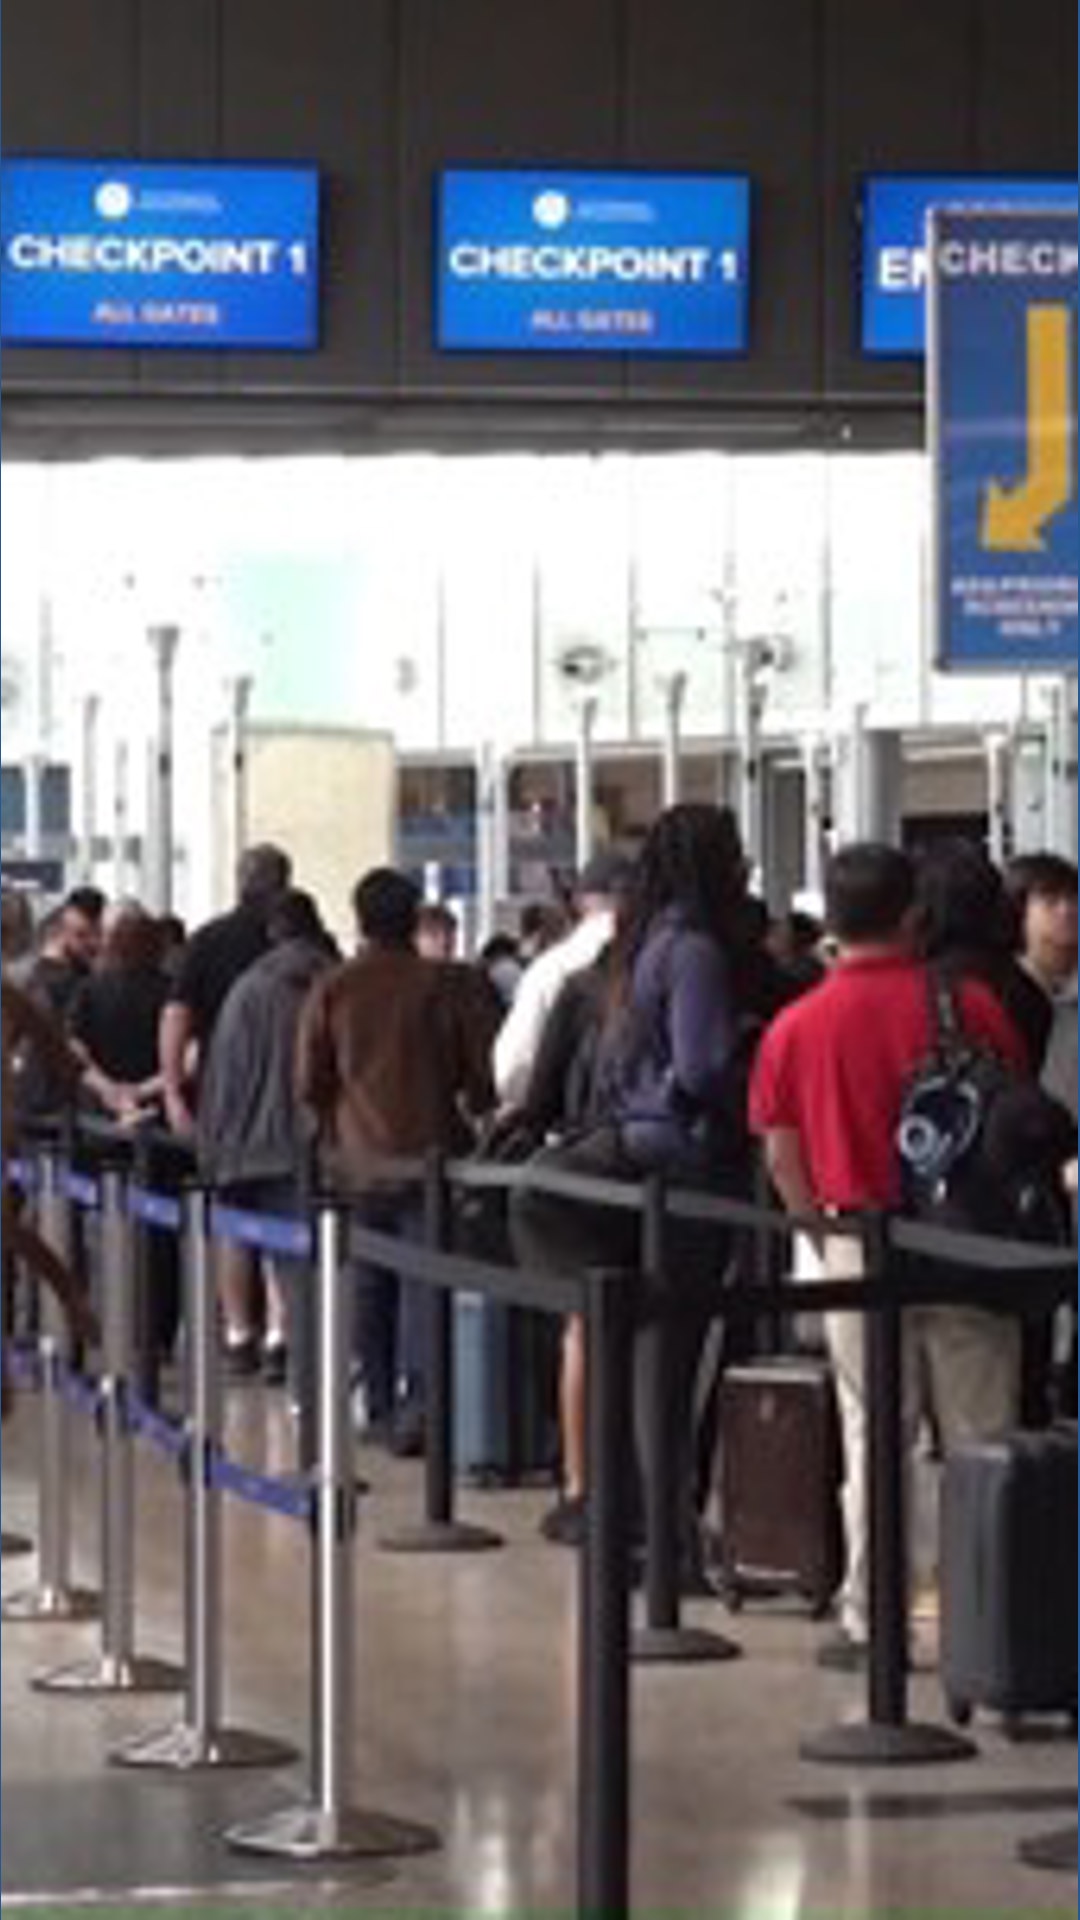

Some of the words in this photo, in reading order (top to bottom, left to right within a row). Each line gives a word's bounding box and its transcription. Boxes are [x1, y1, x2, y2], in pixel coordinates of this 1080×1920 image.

[8, 233, 275, 274] CHECKPOINT
[287, 243, 307, 275] 1
[450, 244, 707, 281] CHECKPOINT
[717, 250, 738, 282] 1
